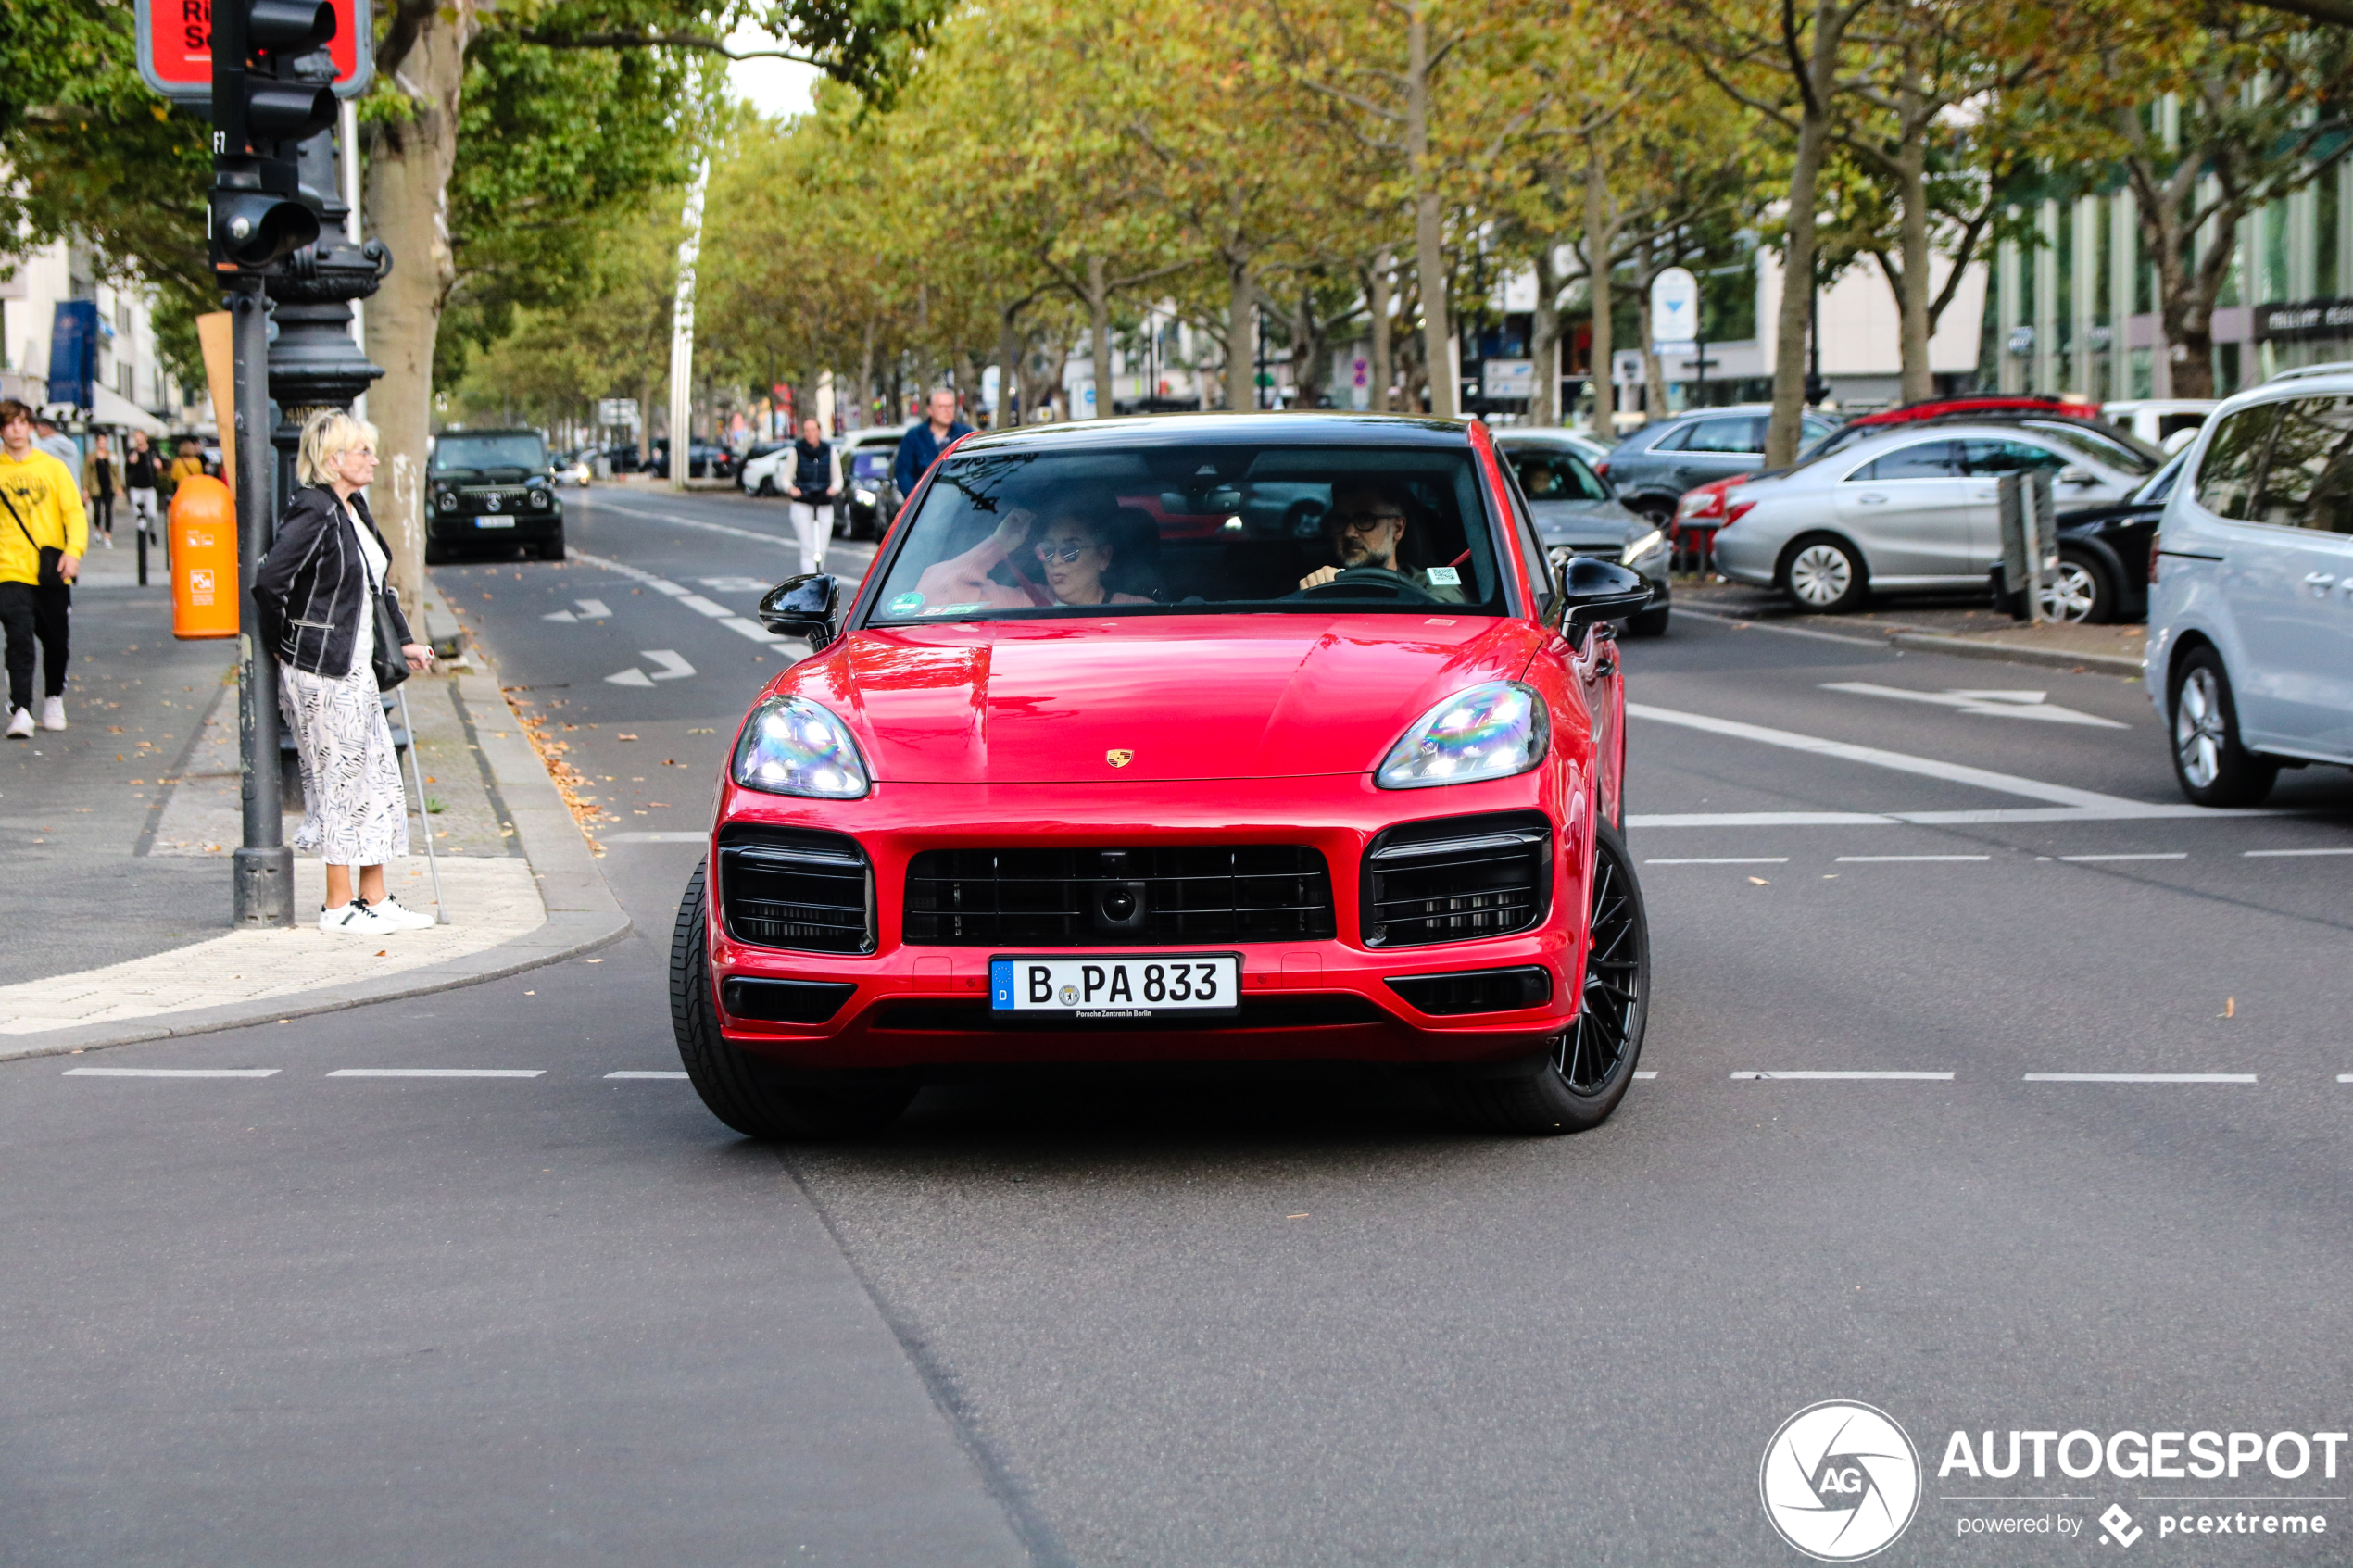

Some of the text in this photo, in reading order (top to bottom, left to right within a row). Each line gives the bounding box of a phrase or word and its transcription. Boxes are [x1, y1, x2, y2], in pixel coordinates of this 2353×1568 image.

[185, 25, 212, 49] S
[999, 989, 1008, 1001] D
[1028, 965, 1053, 1003] B
[1082, 964, 1133, 1003] PA
[1143, 963, 1217, 1002] 833
